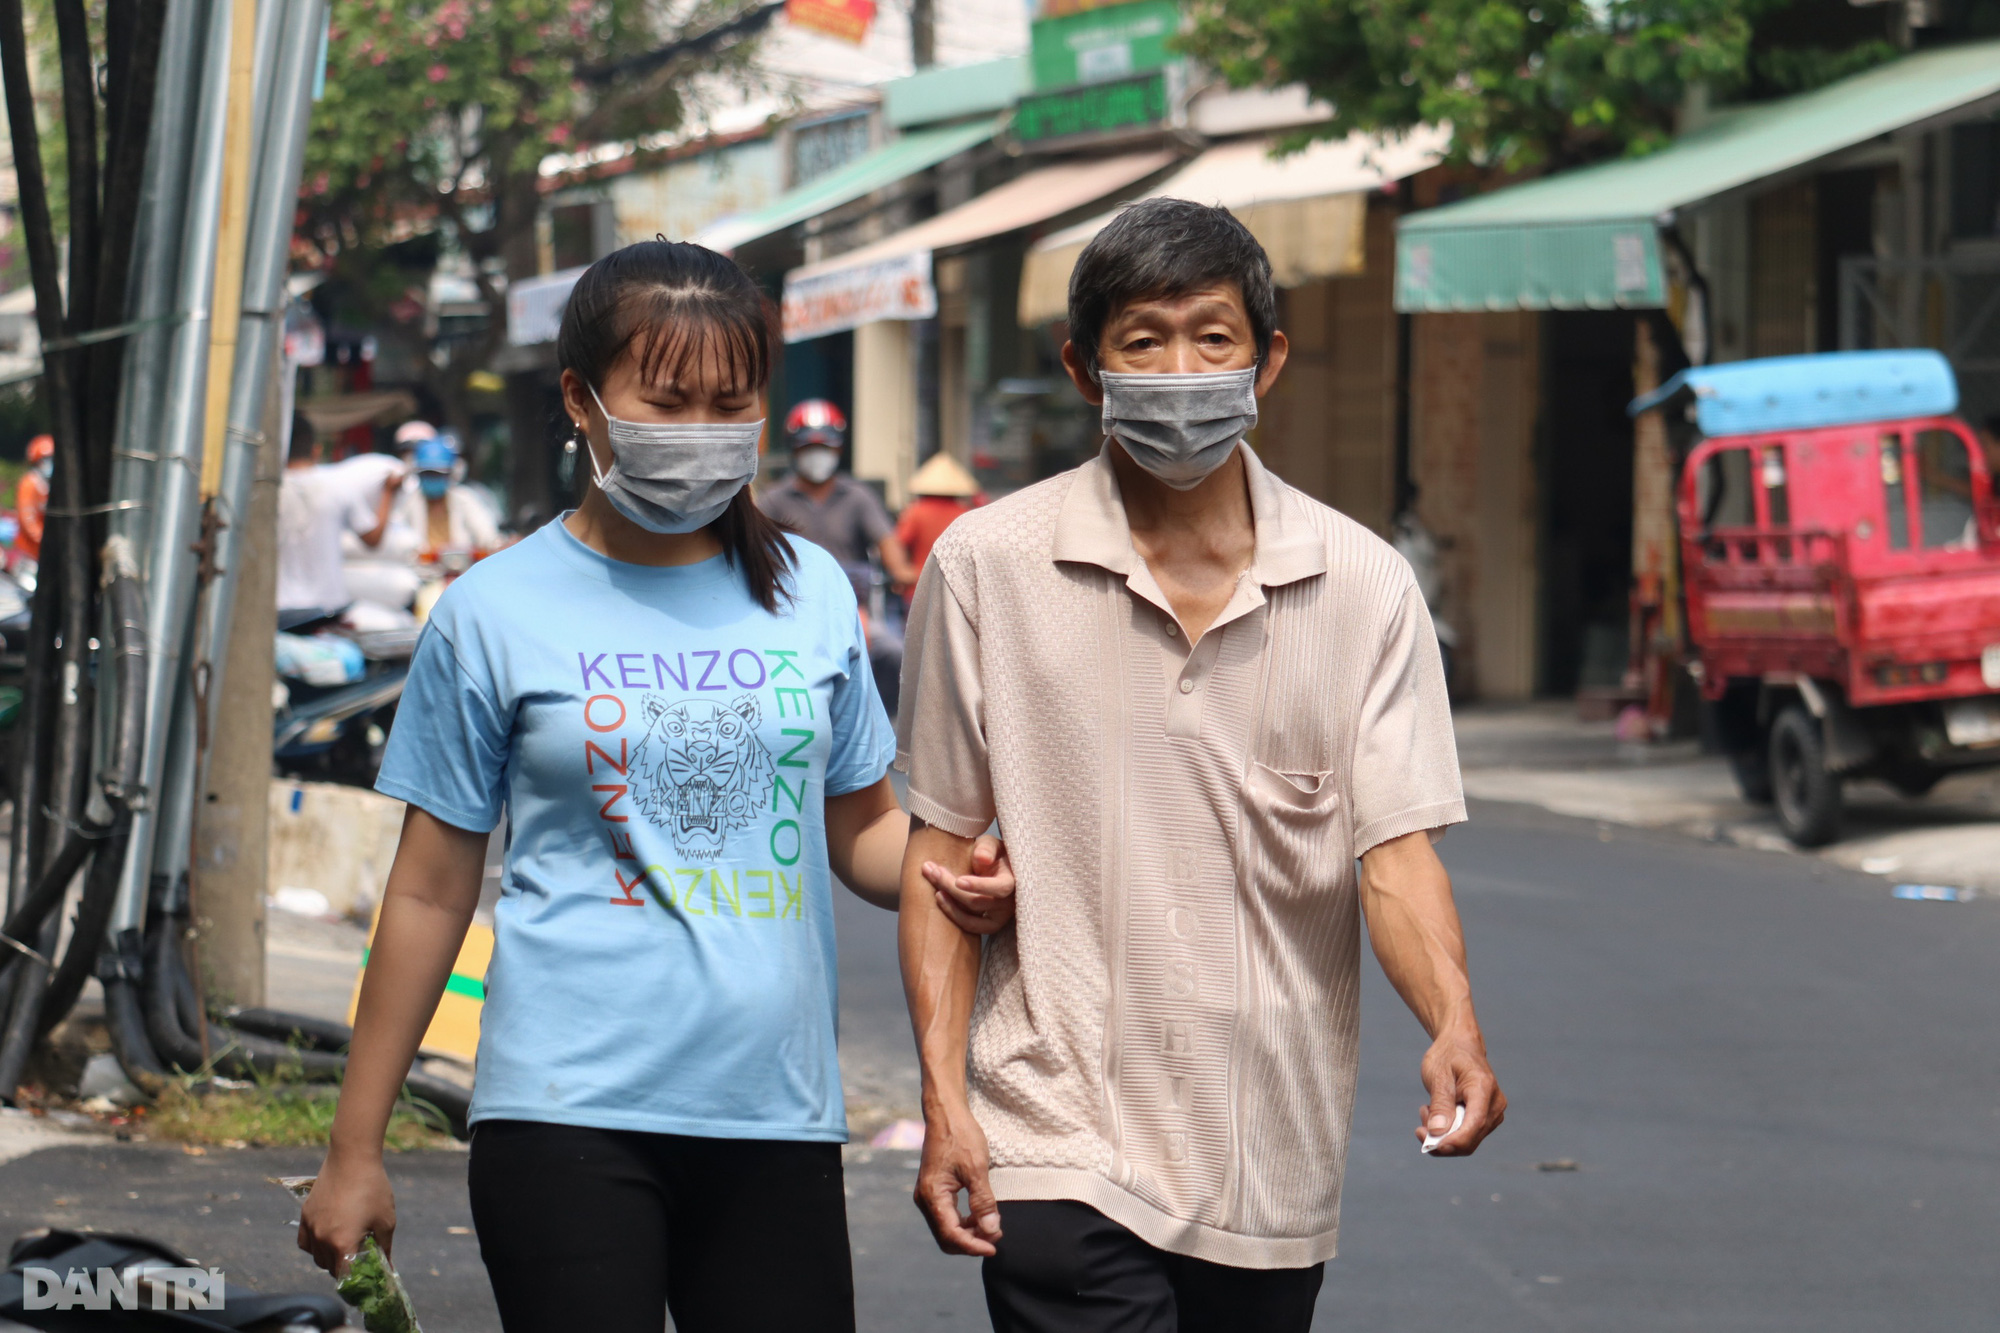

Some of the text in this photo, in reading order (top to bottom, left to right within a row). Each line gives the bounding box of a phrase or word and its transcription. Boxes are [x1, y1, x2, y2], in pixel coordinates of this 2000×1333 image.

[577, 648, 766, 691] KENZO
[764, 649, 815, 867] KENZO
[583, 694, 647, 907] KENZO
[656, 788, 748, 818] KENZO
[646, 864, 802, 921] KENZO
